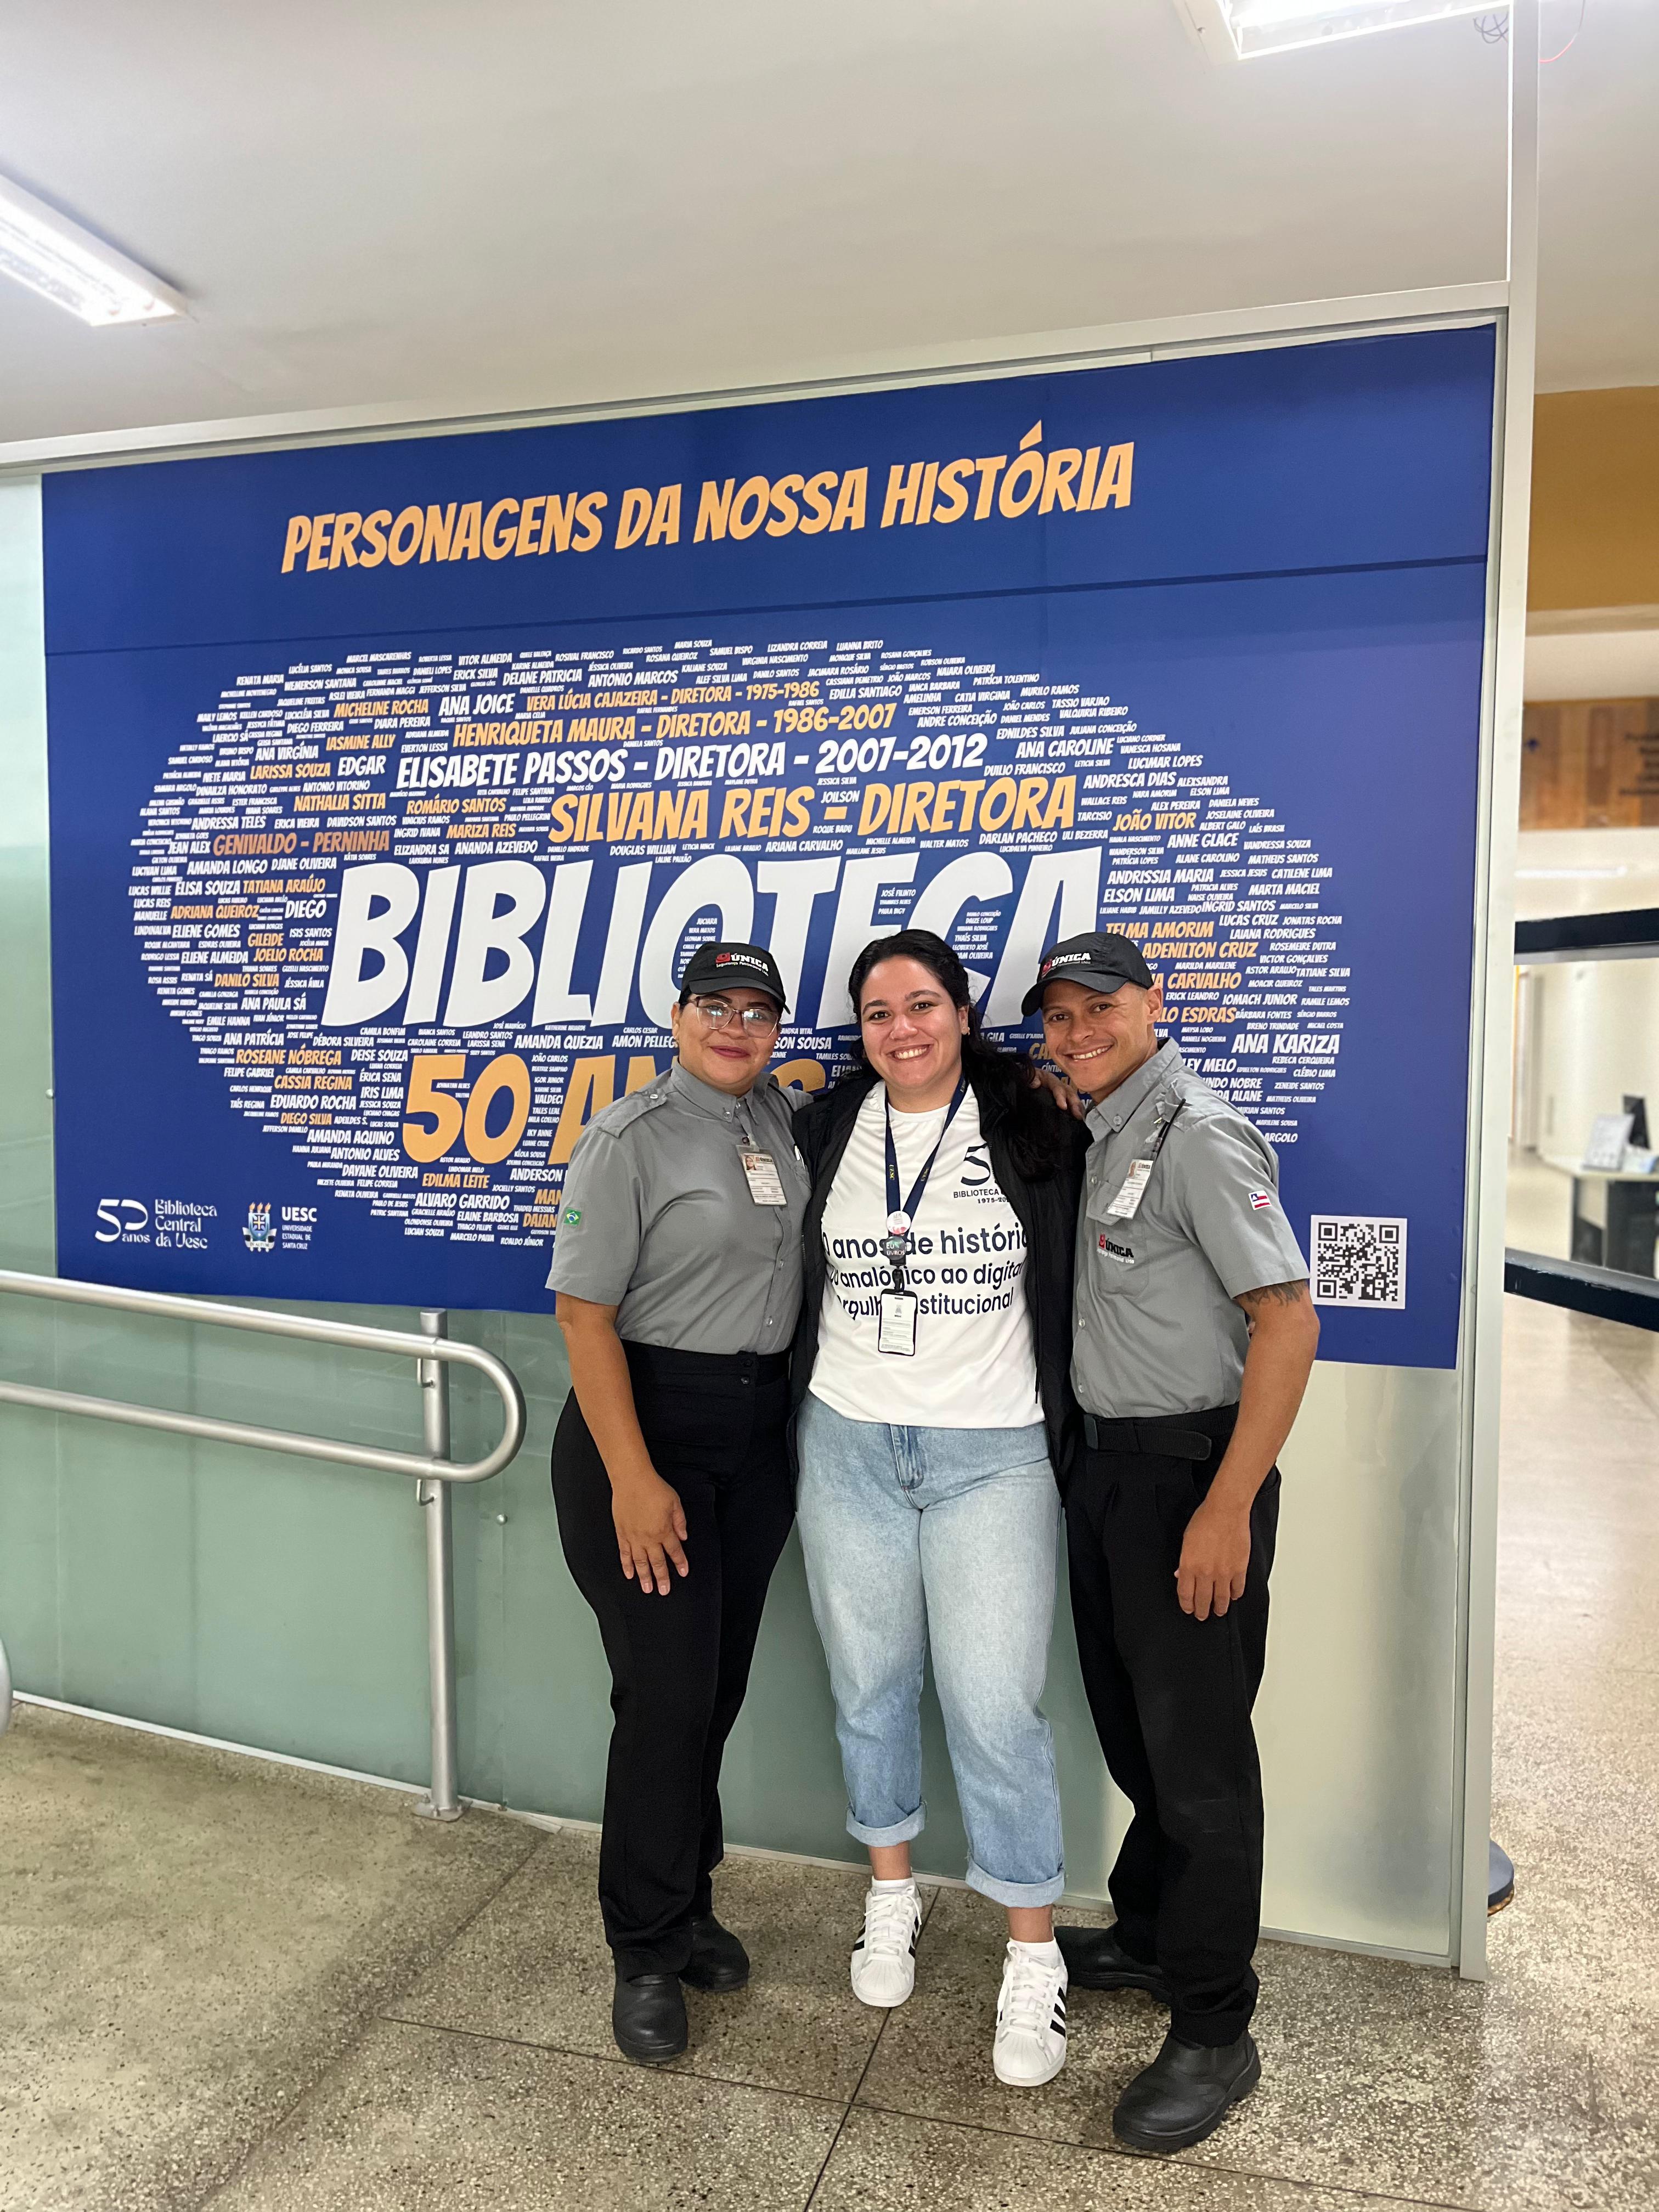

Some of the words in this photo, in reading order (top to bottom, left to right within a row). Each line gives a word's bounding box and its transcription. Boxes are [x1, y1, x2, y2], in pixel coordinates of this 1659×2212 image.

[282, 492, 607, 573] PERSONAGENS
[615, 484, 681, 549] DA
[693, 467, 868, 543] NOSSA
[881, 420, 1133, 528] HISTÓRIA
[768, 642, 798, 652] LIZANDRA
[800, 641, 827, 650] CORREIA
[836, 642, 861, 651] LUANNA
[863, 640, 883, 650] BRITO
[459, 655, 479, 665] VITOR
[481, 653, 512, 664] ALMEIDA
[503, 672, 538, 686] DELANE
[539, 669, 582, 684] PATRICIA
[588, 673, 632, 687] ANTONIO
[634, 670, 678, 685] MARCOS
[527, 695, 555, 711] VERA
[558, 688, 590, 710] LÚCIA
[595, 690, 657, 708] CAJAZEIRA
[670, 686, 731, 704] DIRETORA
[746, 681, 820, 700] 1975-1986
[830, 688, 856, 699] EDILLA
[858, 685, 902, 698] SANTIAGO
[334, 701, 390, 718] MICHELINE
[392, 699, 428, 714] ROCHA
[438, 696, 470, 716] ANA
[473, 693, 515, 714] JOICE
[453, 720, 563, 747] HENRIQUETA
[567, 716, 635, 742] MAURA
[656, 710, 751, 738] DIRETORA
[774, 703, 896, 733] 1986-2007
[917, 716, 946, 727] ANDRE
[948, 710, 997, 726] CONCEIÇÃO
[371, 734, 396, 748] ALLY
[1015, 741, 1045, 758] ANA
[1048, 738, 1115, 757] CAROLINE
[338, 755, 386, 776] EDGAR
[396, 753, 520, 789] ELISABETE
[523, 749, 628, 785] PASSOS
[654, 742, 786, 780] DIRETORA
[815, 733, 988, 774] 2007-2012
[250, 764, 292, 779] LARISSA
[295, 763, 330, 778] SOUZA
[1083, 772, 1145, 789] ANDRESCA
[1148, 772, 1176, 786] DIAS
[294, 794, 349, 811] NATHALIA
[352, 793, 385, 810] SITTA
[407, 793, 459, 814] ROMÁRIO
[462, 798, 506, 813] SANTOS
[549, 789, 709, 843] SILVANA
[719, 786, 815, 838] REIS
[857, 775, 1076, 835] DIRETORA
[191, 816, 238, 830] ANDRESSA
[241, 816, 266, 828] TELES
[1113, 809, 1152, 831] JOÃO
[1155, 812, 1196, 830] VITOR
[447, 824, 489, 838] MARIZA
[492, 823, 516, 837] REIS
[214, 833, 296, 856] GENIVALDO
[313, 831, 389, 852] PERNINHA
[455, 842, 493, 854] ANANDA
[495, 840, 538, 854] AZEVEDO
[1167, 834, 1200, 848] ANNE
[1201, 833, 1239, 847] GLACE
[244, 880, 283, 893] TATIANA
[285, 874, 325, 893] ARAÚJO
[1107, 870, 1171, 884] ANDRISSIA
[1173, 868, 1214, 883] MARIA
[174, 881, 202, 896] ELISA
[205, 880, 240, 895] SOUZA
[1103, 888, 1143, 902] ELSON
[1144, 887, 1175, 902] LIMA
[171, 905, 213, 918] ADRIANA
[216, 905, 259, 919] QUEIROZ
[285, 900, 326, 918] DIEGO
[321, 847, 1102, 1030] BIBLIOTECA
[1151, 922, 1214, 938] AMORIM
[248, 933, 284, 947] GILEIDE
[253, 948, 286, 961] JOELIO
[289, 948, 323, 961] ROCHA
[1142, 941, 1217, 958] ADENILTON
[1219, 942, 1259, 958] CRUZ
[730, 953, 769, 972] ÚNICA
[1051, 953, 1091, 967] ÚNICA
[215, 973, 250, 986] DANILO
[252, 974, 279, 986] SILVA
[1167, 972, 1241, 989] CARVALHO
[241, 997, 260, 1009] ANA
[262, 997, 291, 1011] PAULA
[294, 992, 306, 1010] SÁ
[1181, 1007, 1237, 1024] ESDRAS
[514, 1035, 561, 1049] AMANDA
[564, 1035, 603, 1049] QUEZIA
[1231, 1034, 1268, 1053] ANA
[1273, 1034, 1340, 1053] KARIZA
[236, 1049, 286, 1064] ROSEANE
[288, 1043, 341, 1065] NÓBREGA
[274, 1075, 311, 1089] CASSIA
[314, 1076, 352, 1090] REGINA
[360, 1086, 380, 1098] IRIS
[381, 1087, 403, 1099] LIMA
[535, 1094, 563, 1104] VALDECI
[270, 1095, 318, 1109] EDUARDO
[320, 1096, 356, 1109] ROCHA
[403, 1054, 530, 1164] 50
[307, 1130, 351, 1143] AMANDA
[353, 1131, 394, 1144] AQUINO
[422, 1173, 460, 1187] EDILMA
[463, 1175, 489, 1188] LEITE
[415, 1193, 456, 1207] ALVARO
[459, 1194, 509, 1209] GARRIDO
[953, 1188, 999, 1198] BIBLIOTECA
[155, 1199, 217, 1216] Biblioteca
[282, 1207, 317, 1221] UESC
[155, 1216, 201, 1232] Central
[122, 1234, 150, 1243] anos
[155, 1232, 172, 1247] da
[176, 1233, 208, 1249] Uesc
[1105, 1238, 1134, 1258] ÚNICA
[840, 1266, 935, 1290] analóico
[942, 1267, 967, 1284] ao
[973, 1260, 1024, 1290] digita
[919, 1287, 1014, 1314] stitucional
